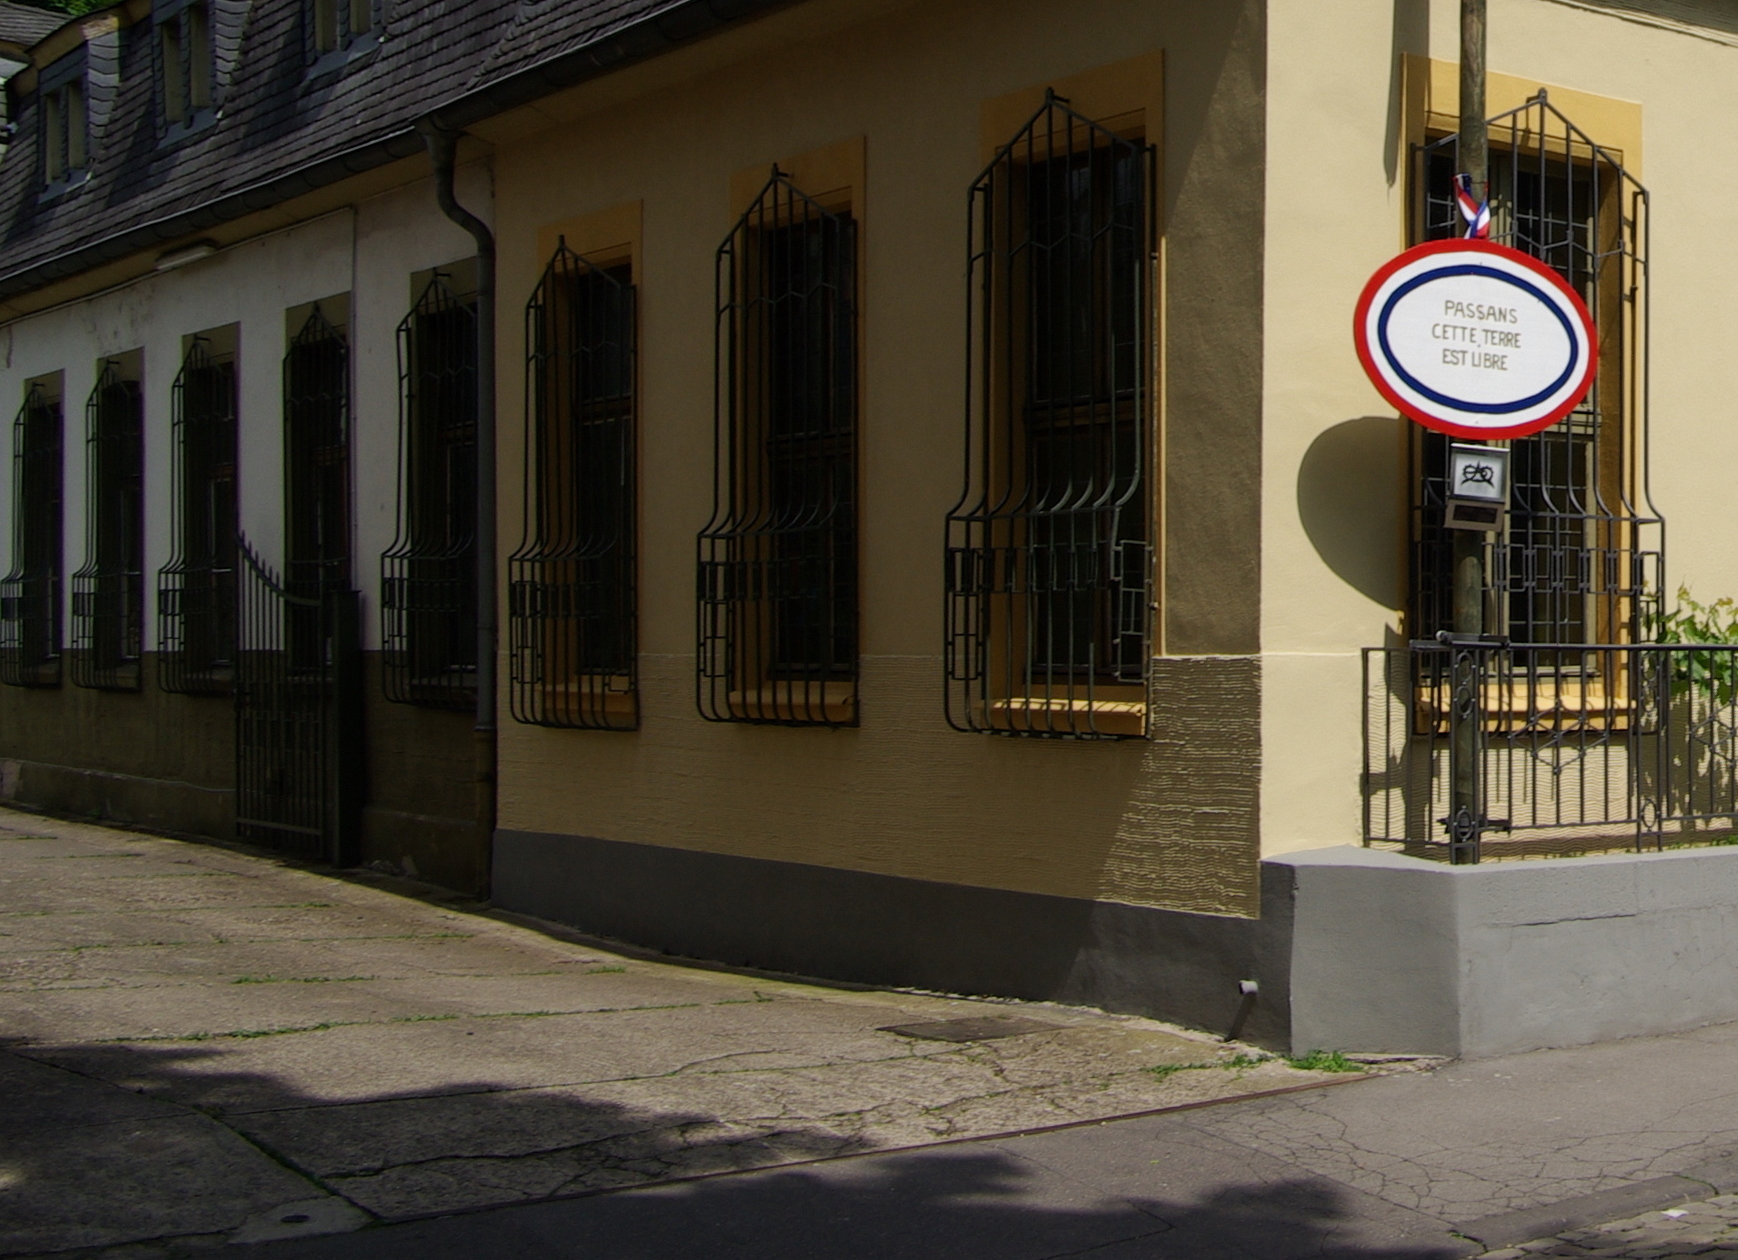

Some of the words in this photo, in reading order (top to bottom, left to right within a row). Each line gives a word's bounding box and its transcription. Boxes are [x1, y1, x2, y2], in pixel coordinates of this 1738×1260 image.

[1444, 300, 1518, 324] PASSANS
[1432, 323, 1477, 343] CETTE
[1482, 329, 1521, 348] TERRE
[1442, 348, 1468, 366] EST
[1471, 351, 1508, 371] LIBRE
